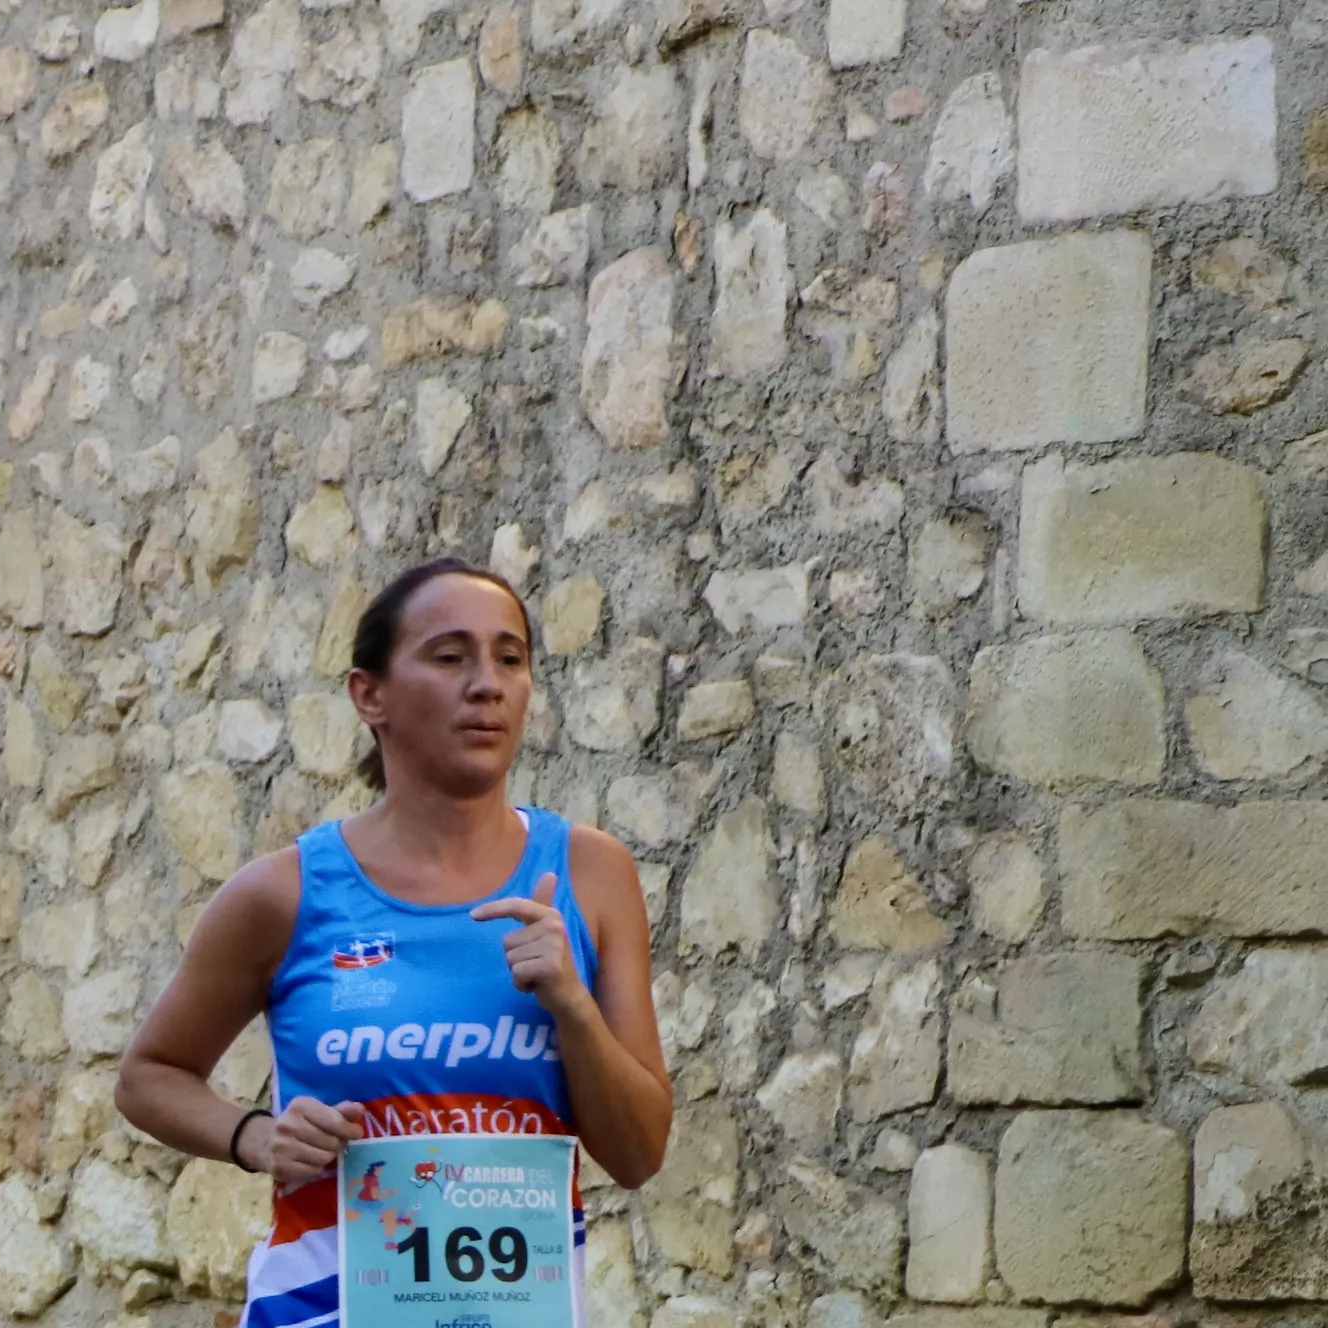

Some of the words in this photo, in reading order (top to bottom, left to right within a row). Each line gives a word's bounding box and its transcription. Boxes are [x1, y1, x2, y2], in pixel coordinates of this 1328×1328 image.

[364, 1101, 543, 1139] Maratón
[445, 1163, 465, 1182] IV
[463, 1166, 525, 1184] CARRERA
[397, 1226, 528, 1282] 169
[394, 1292, 446, 1303] MARICELI
[449, 1291, 489, 1302] MUÑOZ
[492, 1291, 531, 1302] MUÑOZ
